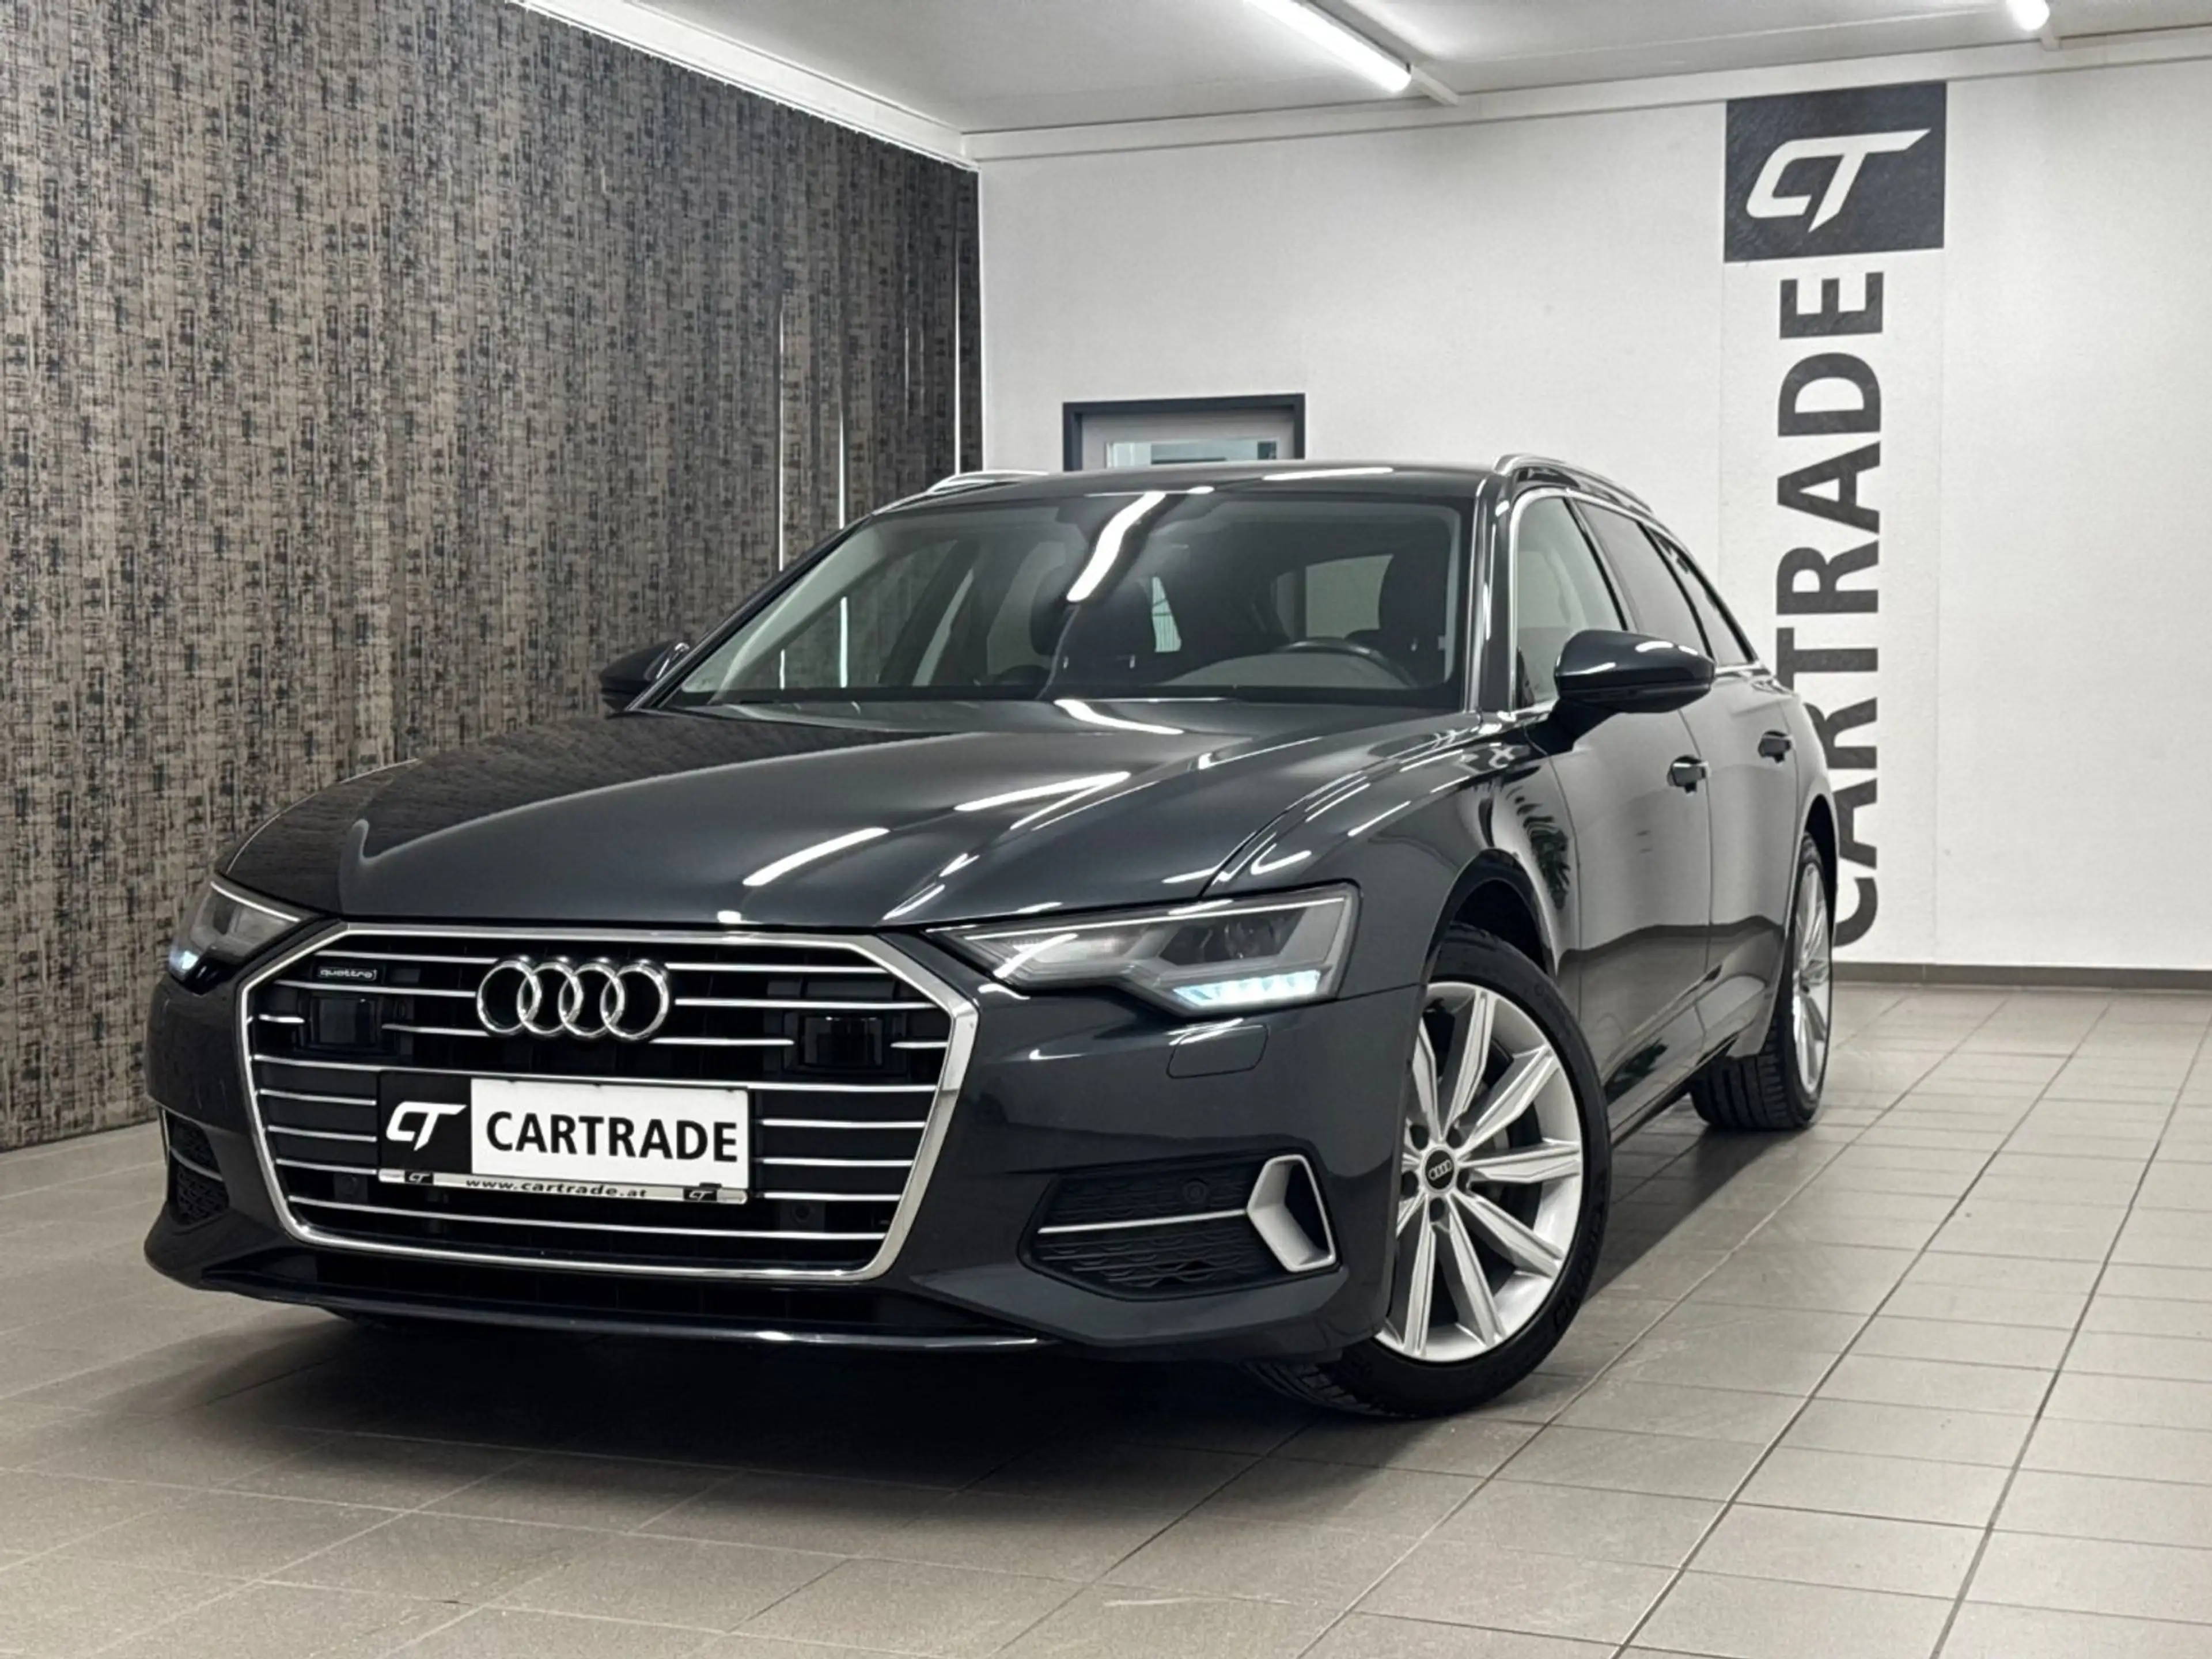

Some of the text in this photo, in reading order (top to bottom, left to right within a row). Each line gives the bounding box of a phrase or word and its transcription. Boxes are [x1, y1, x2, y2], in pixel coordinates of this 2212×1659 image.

[386, 1101, 738, 1162] CT CARTRADE
[465, 1179, 646, 1198] www.cartrade.at
